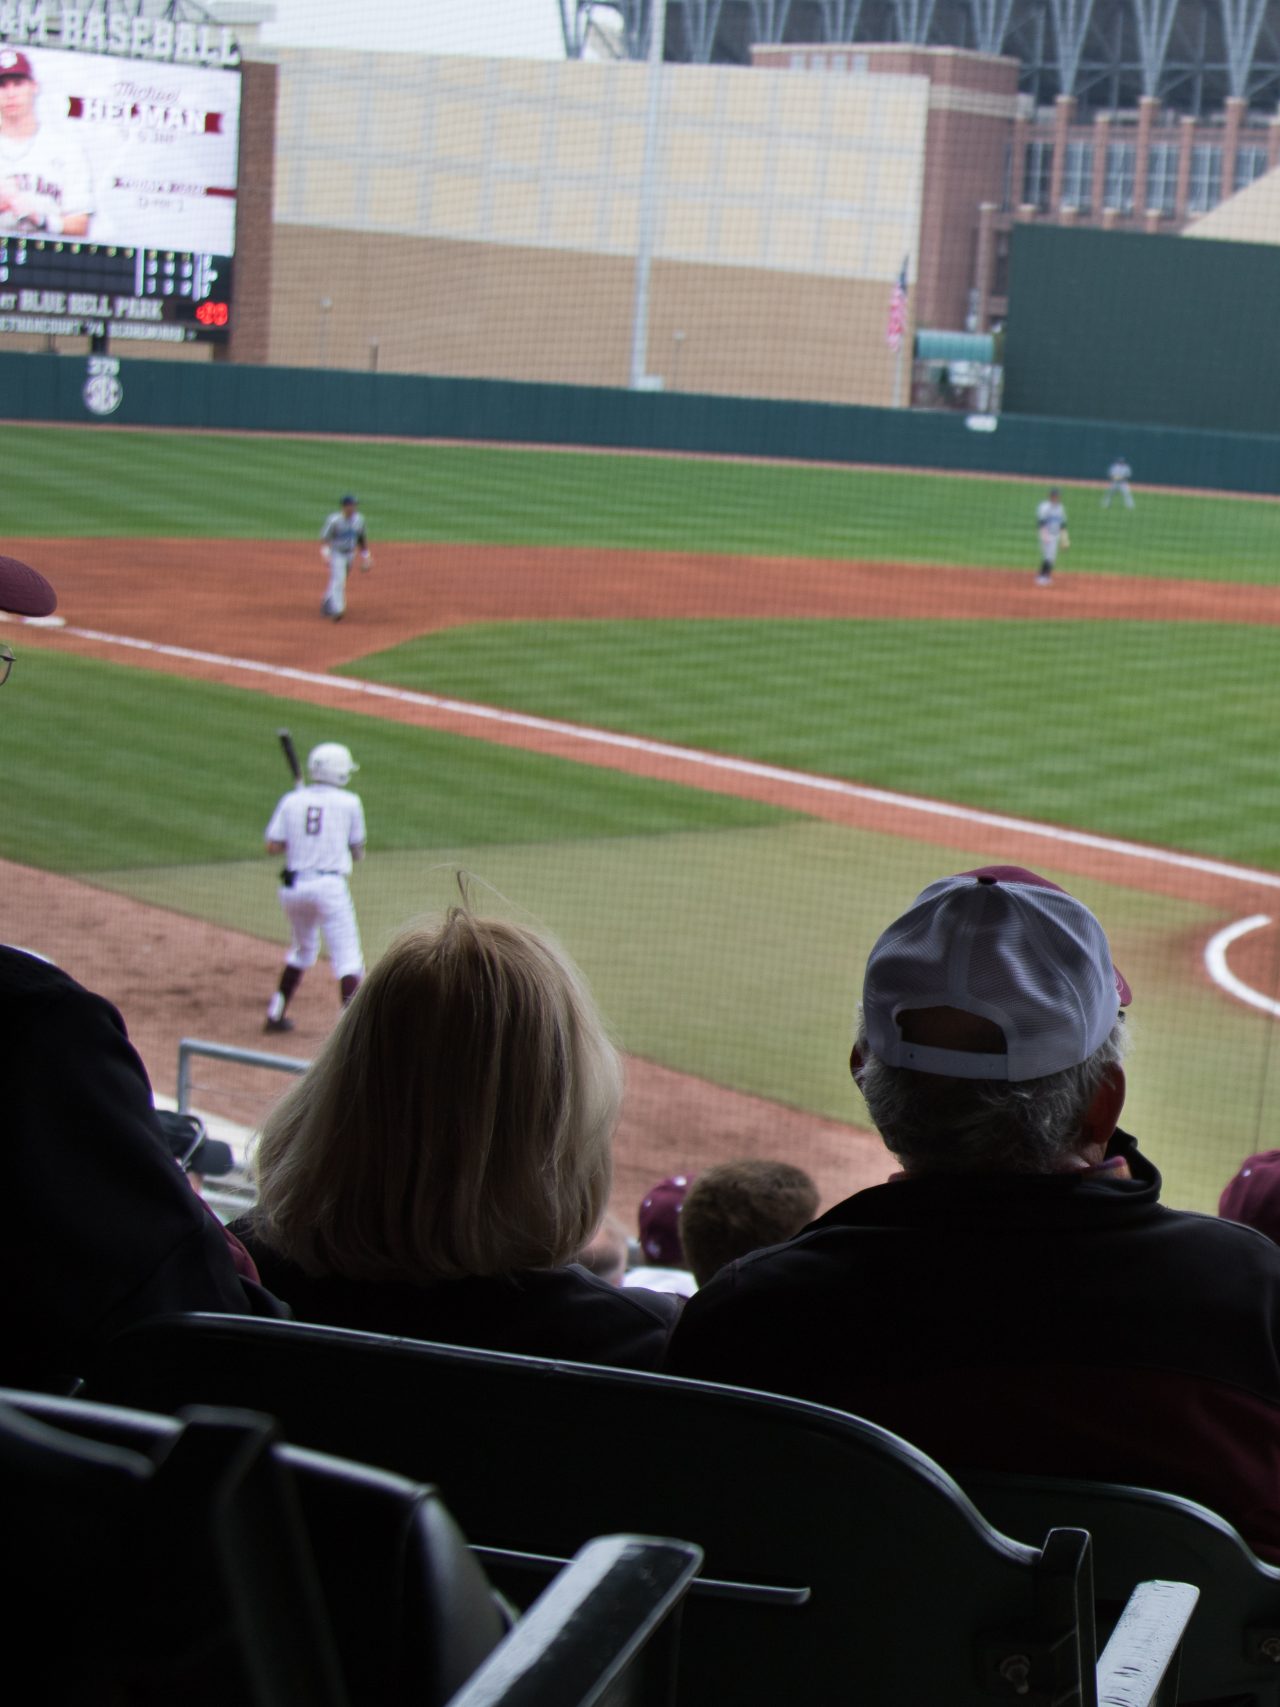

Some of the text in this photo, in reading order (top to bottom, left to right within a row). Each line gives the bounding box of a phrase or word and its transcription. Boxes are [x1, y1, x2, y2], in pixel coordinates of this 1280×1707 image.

[62, 9, 241, 67] BASEBALL
[19, 290, 66, 313] BLUE
[68, 293, 112, 317] BELL
[115, 297, 164, 320] PARK
[305, 806, 323, 835] 8
